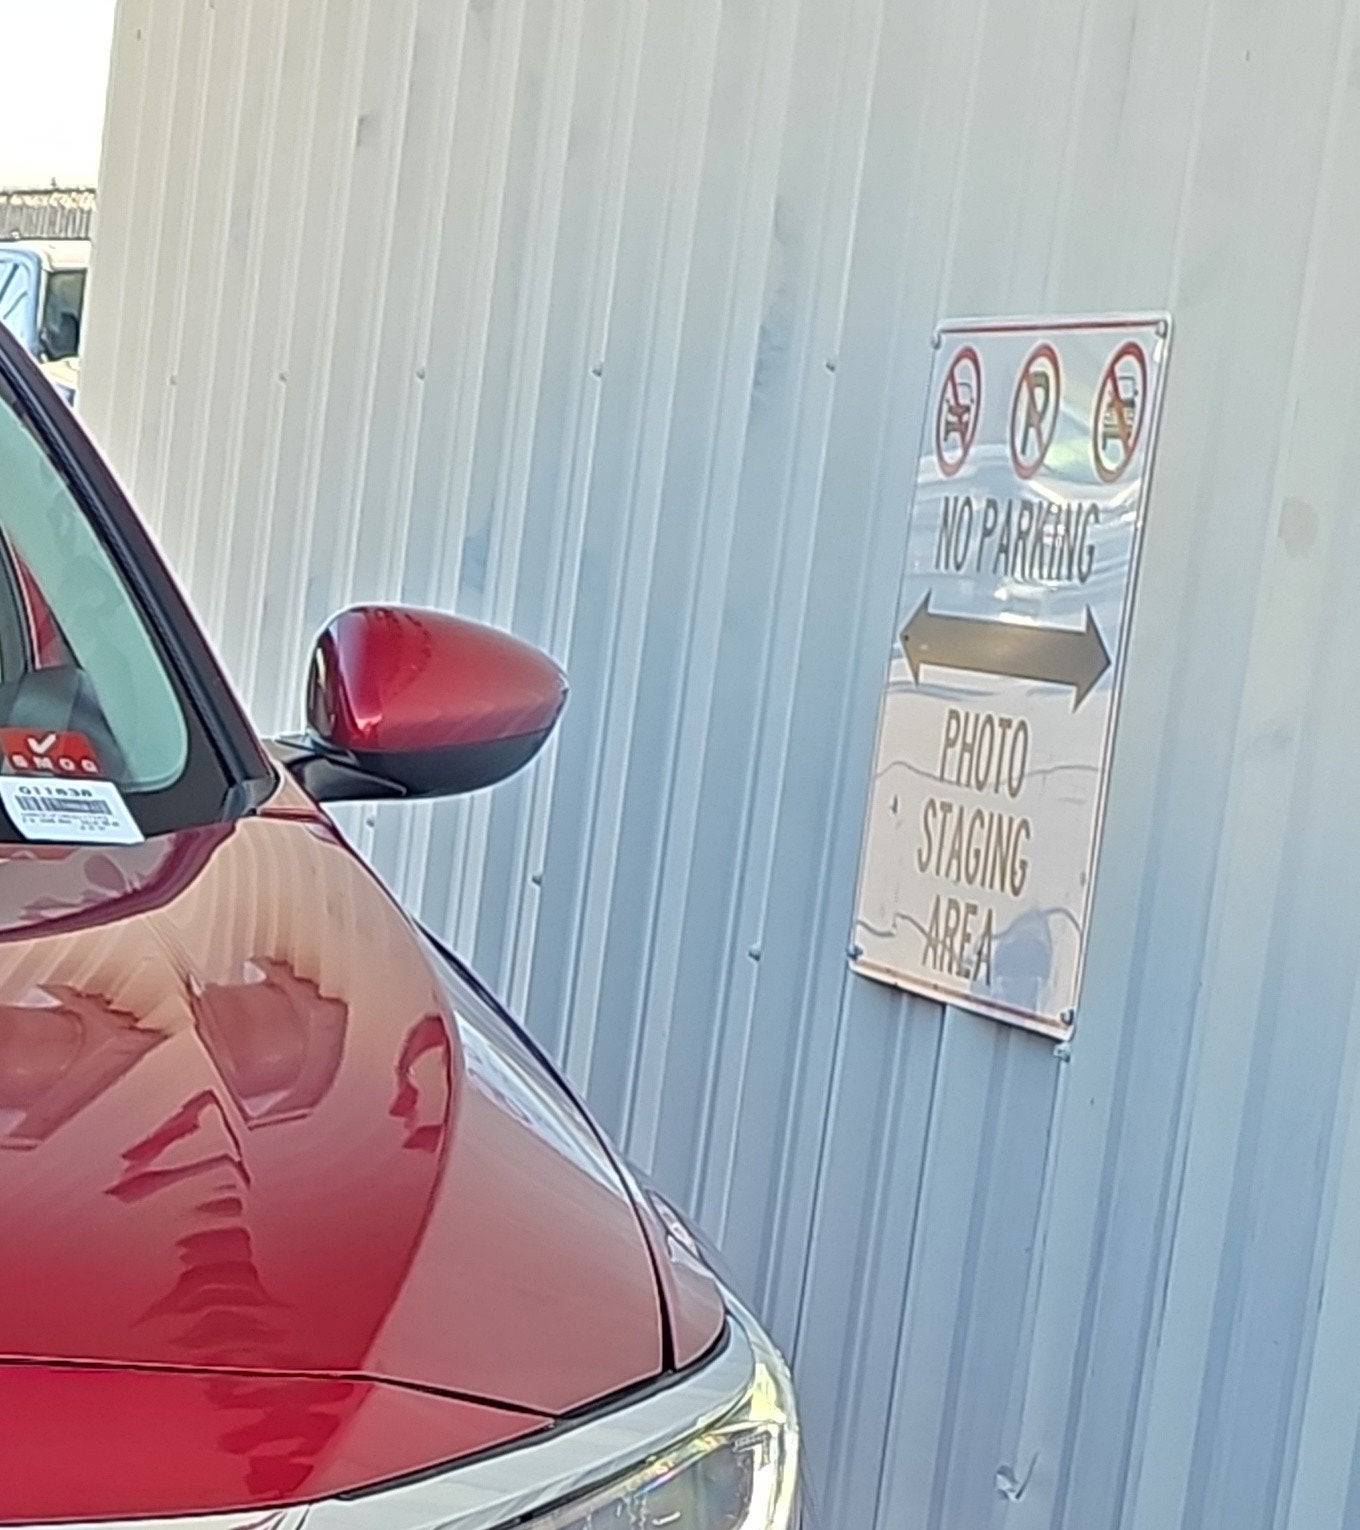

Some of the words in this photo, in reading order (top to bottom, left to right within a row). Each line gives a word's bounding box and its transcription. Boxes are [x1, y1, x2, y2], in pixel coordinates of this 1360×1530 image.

[935, 495, 974, 572] NO
[976, 497, 1102, 585] PARKING
[938, 708, 1030, 799] PHOTO
[916, 797, 1032, 898] STAGING
[921, 896, 995, 987] AREA
